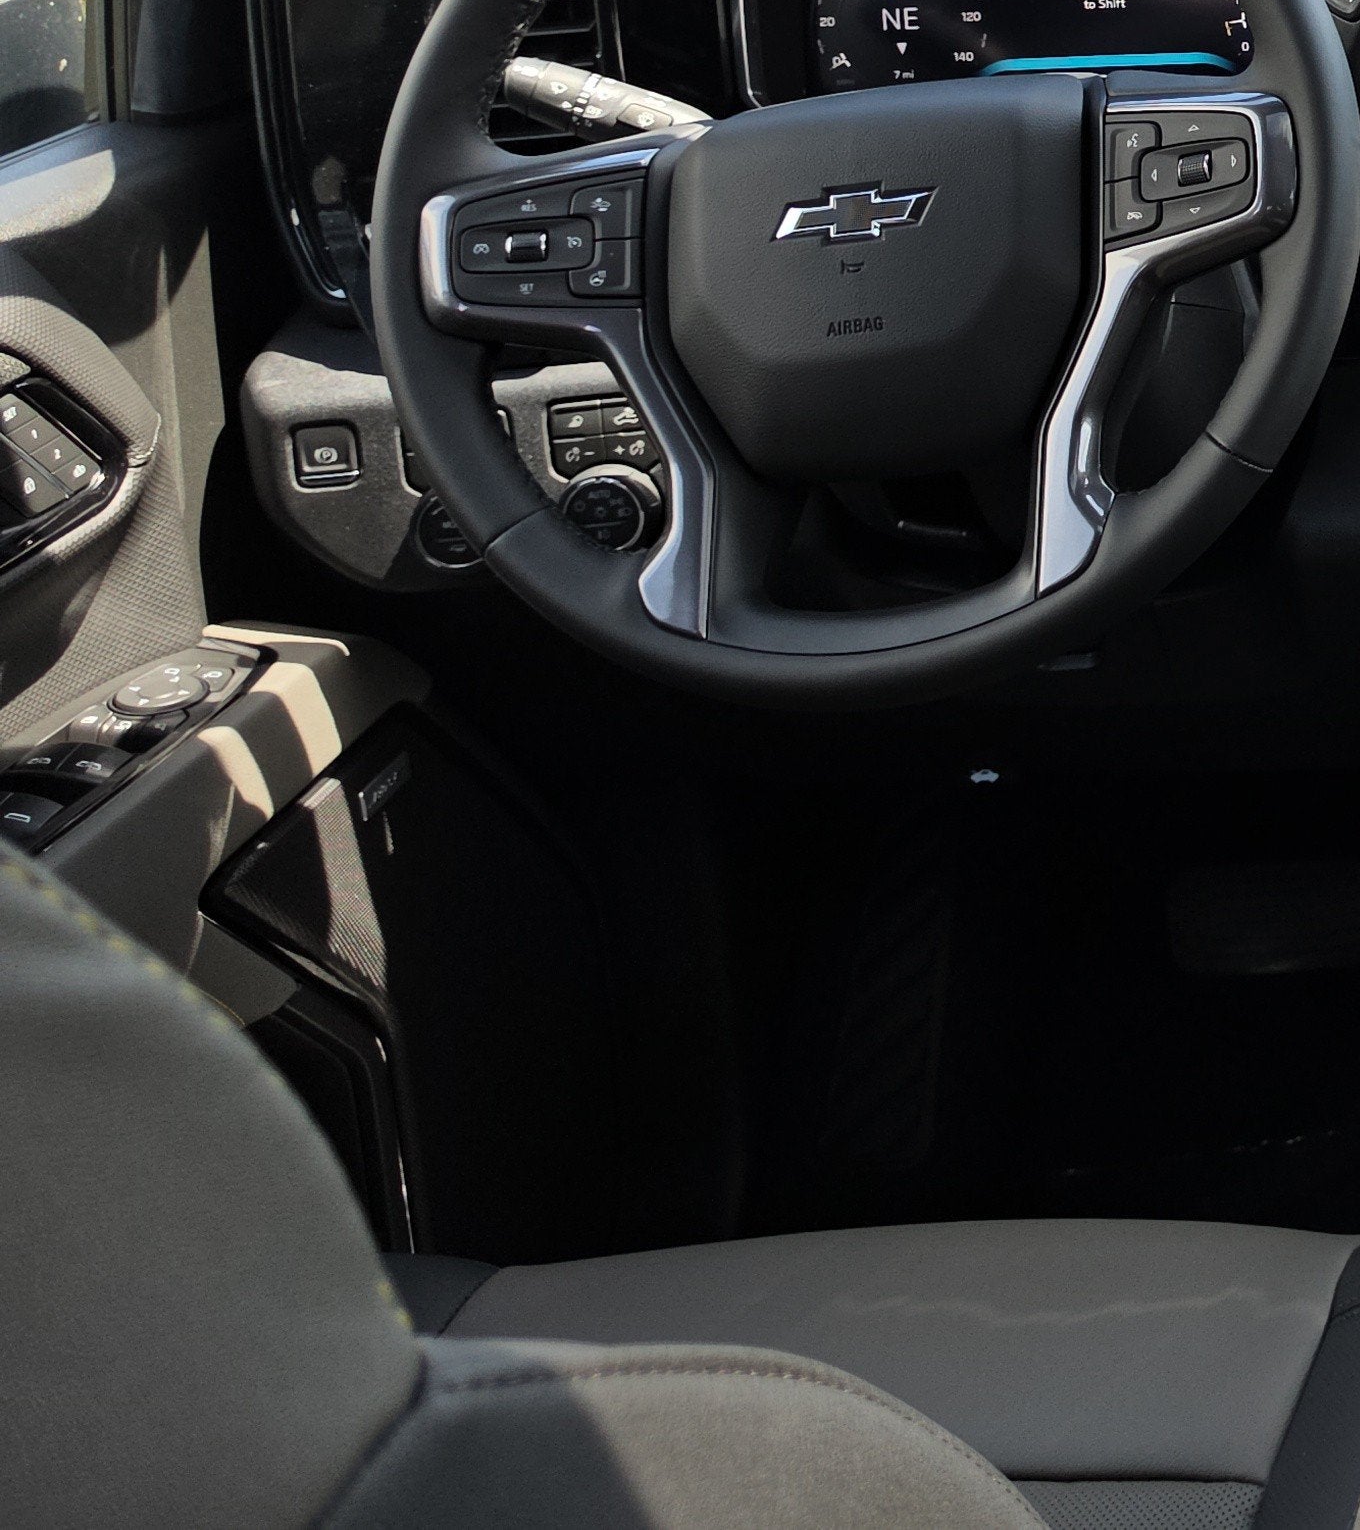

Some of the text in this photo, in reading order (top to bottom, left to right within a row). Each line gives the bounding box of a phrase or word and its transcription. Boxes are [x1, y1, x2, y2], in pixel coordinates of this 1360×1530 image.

[1083, 0, 1096, 10] to
[819, 16, 836, 27] 20
[881, 7, 920, 31] NE
[961, 11, 982, 22] 120
[953, 52, 974, 62] 140
[521, 203, 537, 212] RES
[519, 283, 534, 292] SET
[826, 316, 884, 338] AIRBAG
